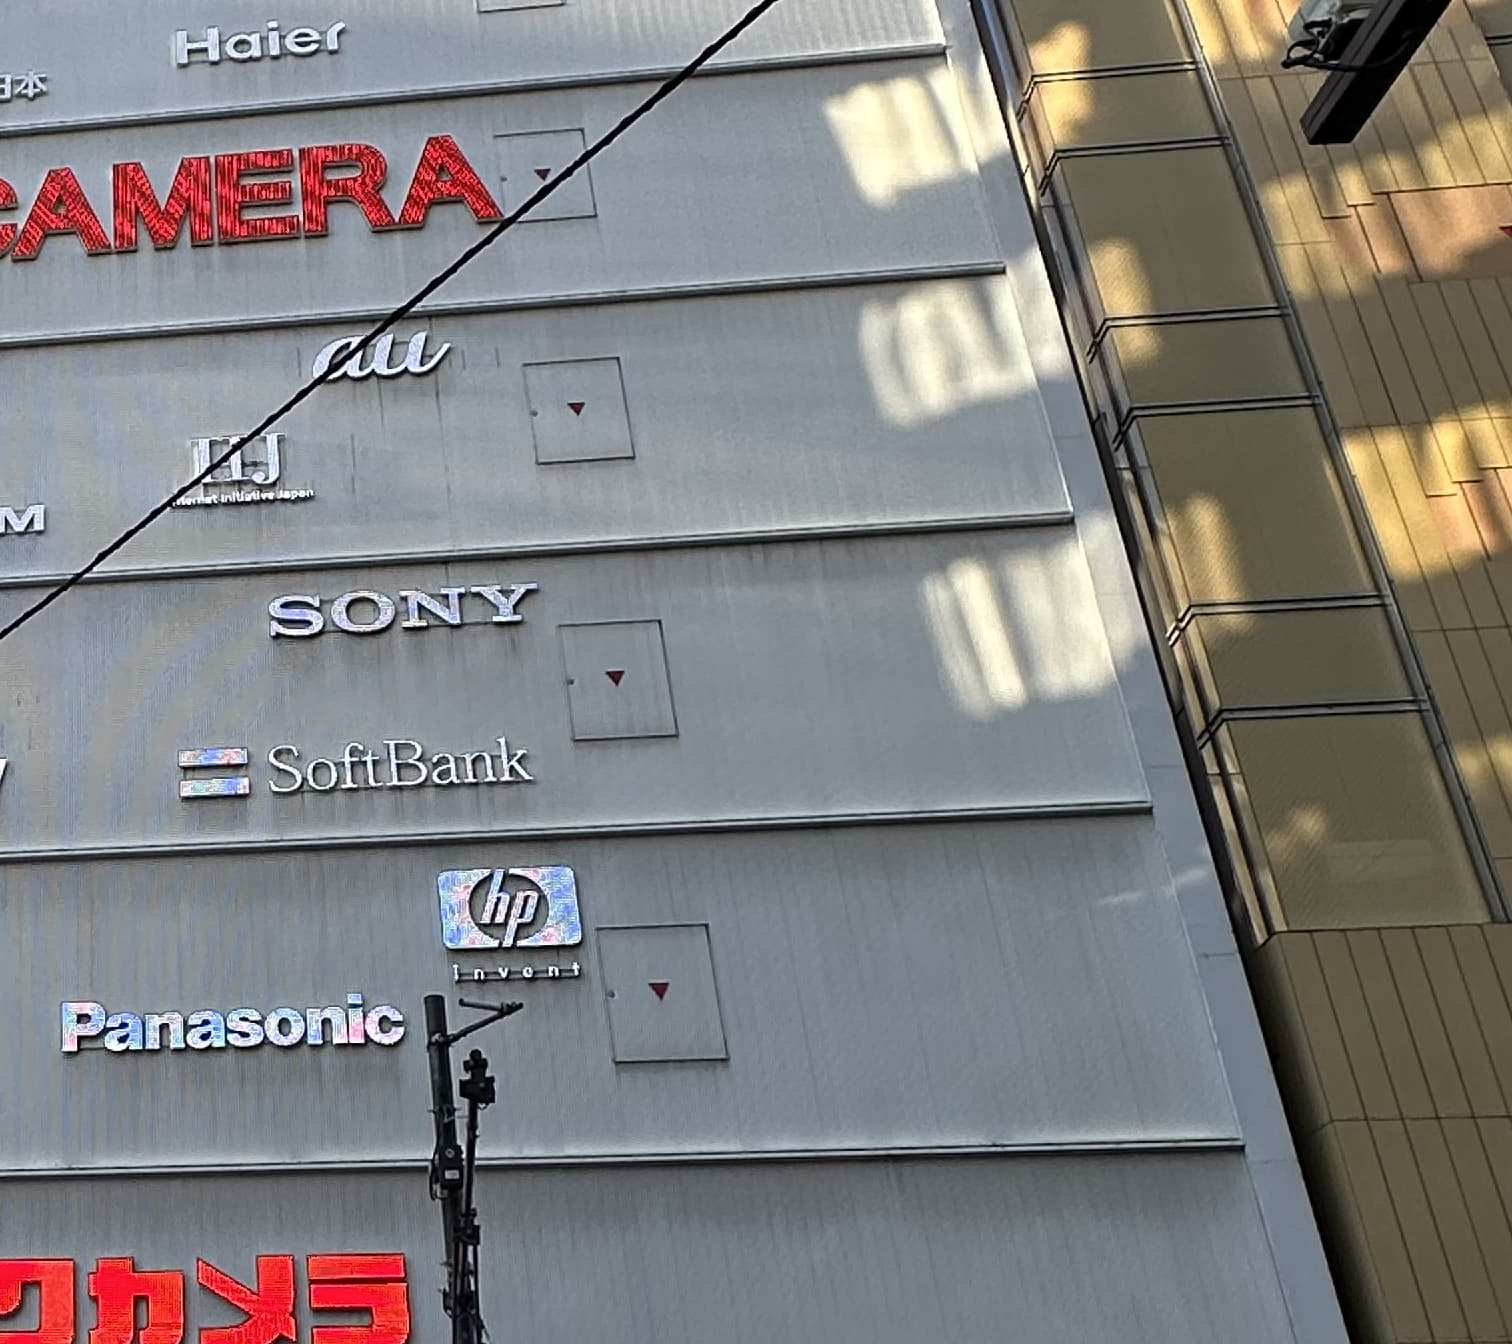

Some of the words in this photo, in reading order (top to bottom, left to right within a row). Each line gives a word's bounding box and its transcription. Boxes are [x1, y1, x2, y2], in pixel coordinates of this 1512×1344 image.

[173, 19, 347, 68] Haier
[312, 330, 451, 384] au
[172, 494, 218, 508] nternet
[267, 581, 539, 640] SONY
[266, 738, 533, 796] SoftBank
[479, 868, 539, 948] hp
[59, 991, 405, 1053] Panasonic
